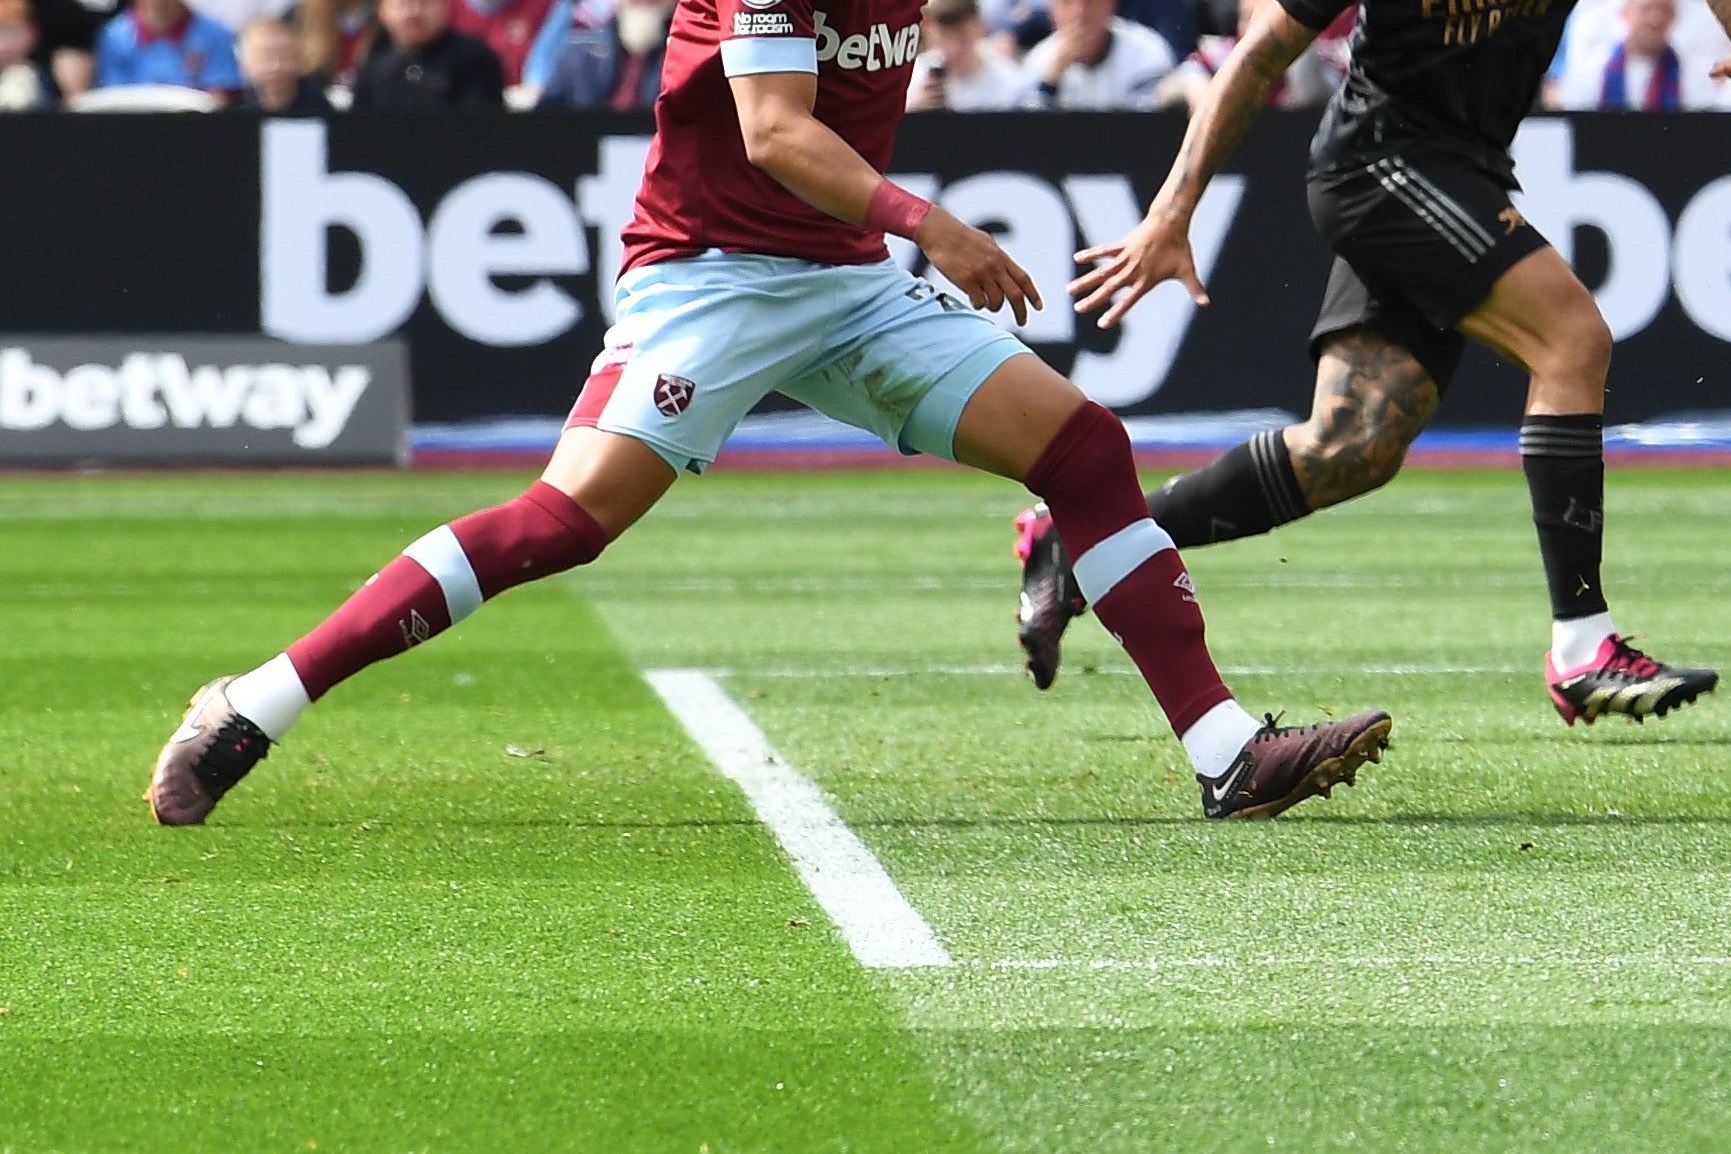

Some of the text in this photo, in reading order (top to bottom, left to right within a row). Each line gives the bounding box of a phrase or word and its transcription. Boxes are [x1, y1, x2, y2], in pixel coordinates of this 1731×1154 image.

[753, 12, 787, 24] room
[812, 10, 920, 71] betwa
[0, 347, 372, 449] betway
